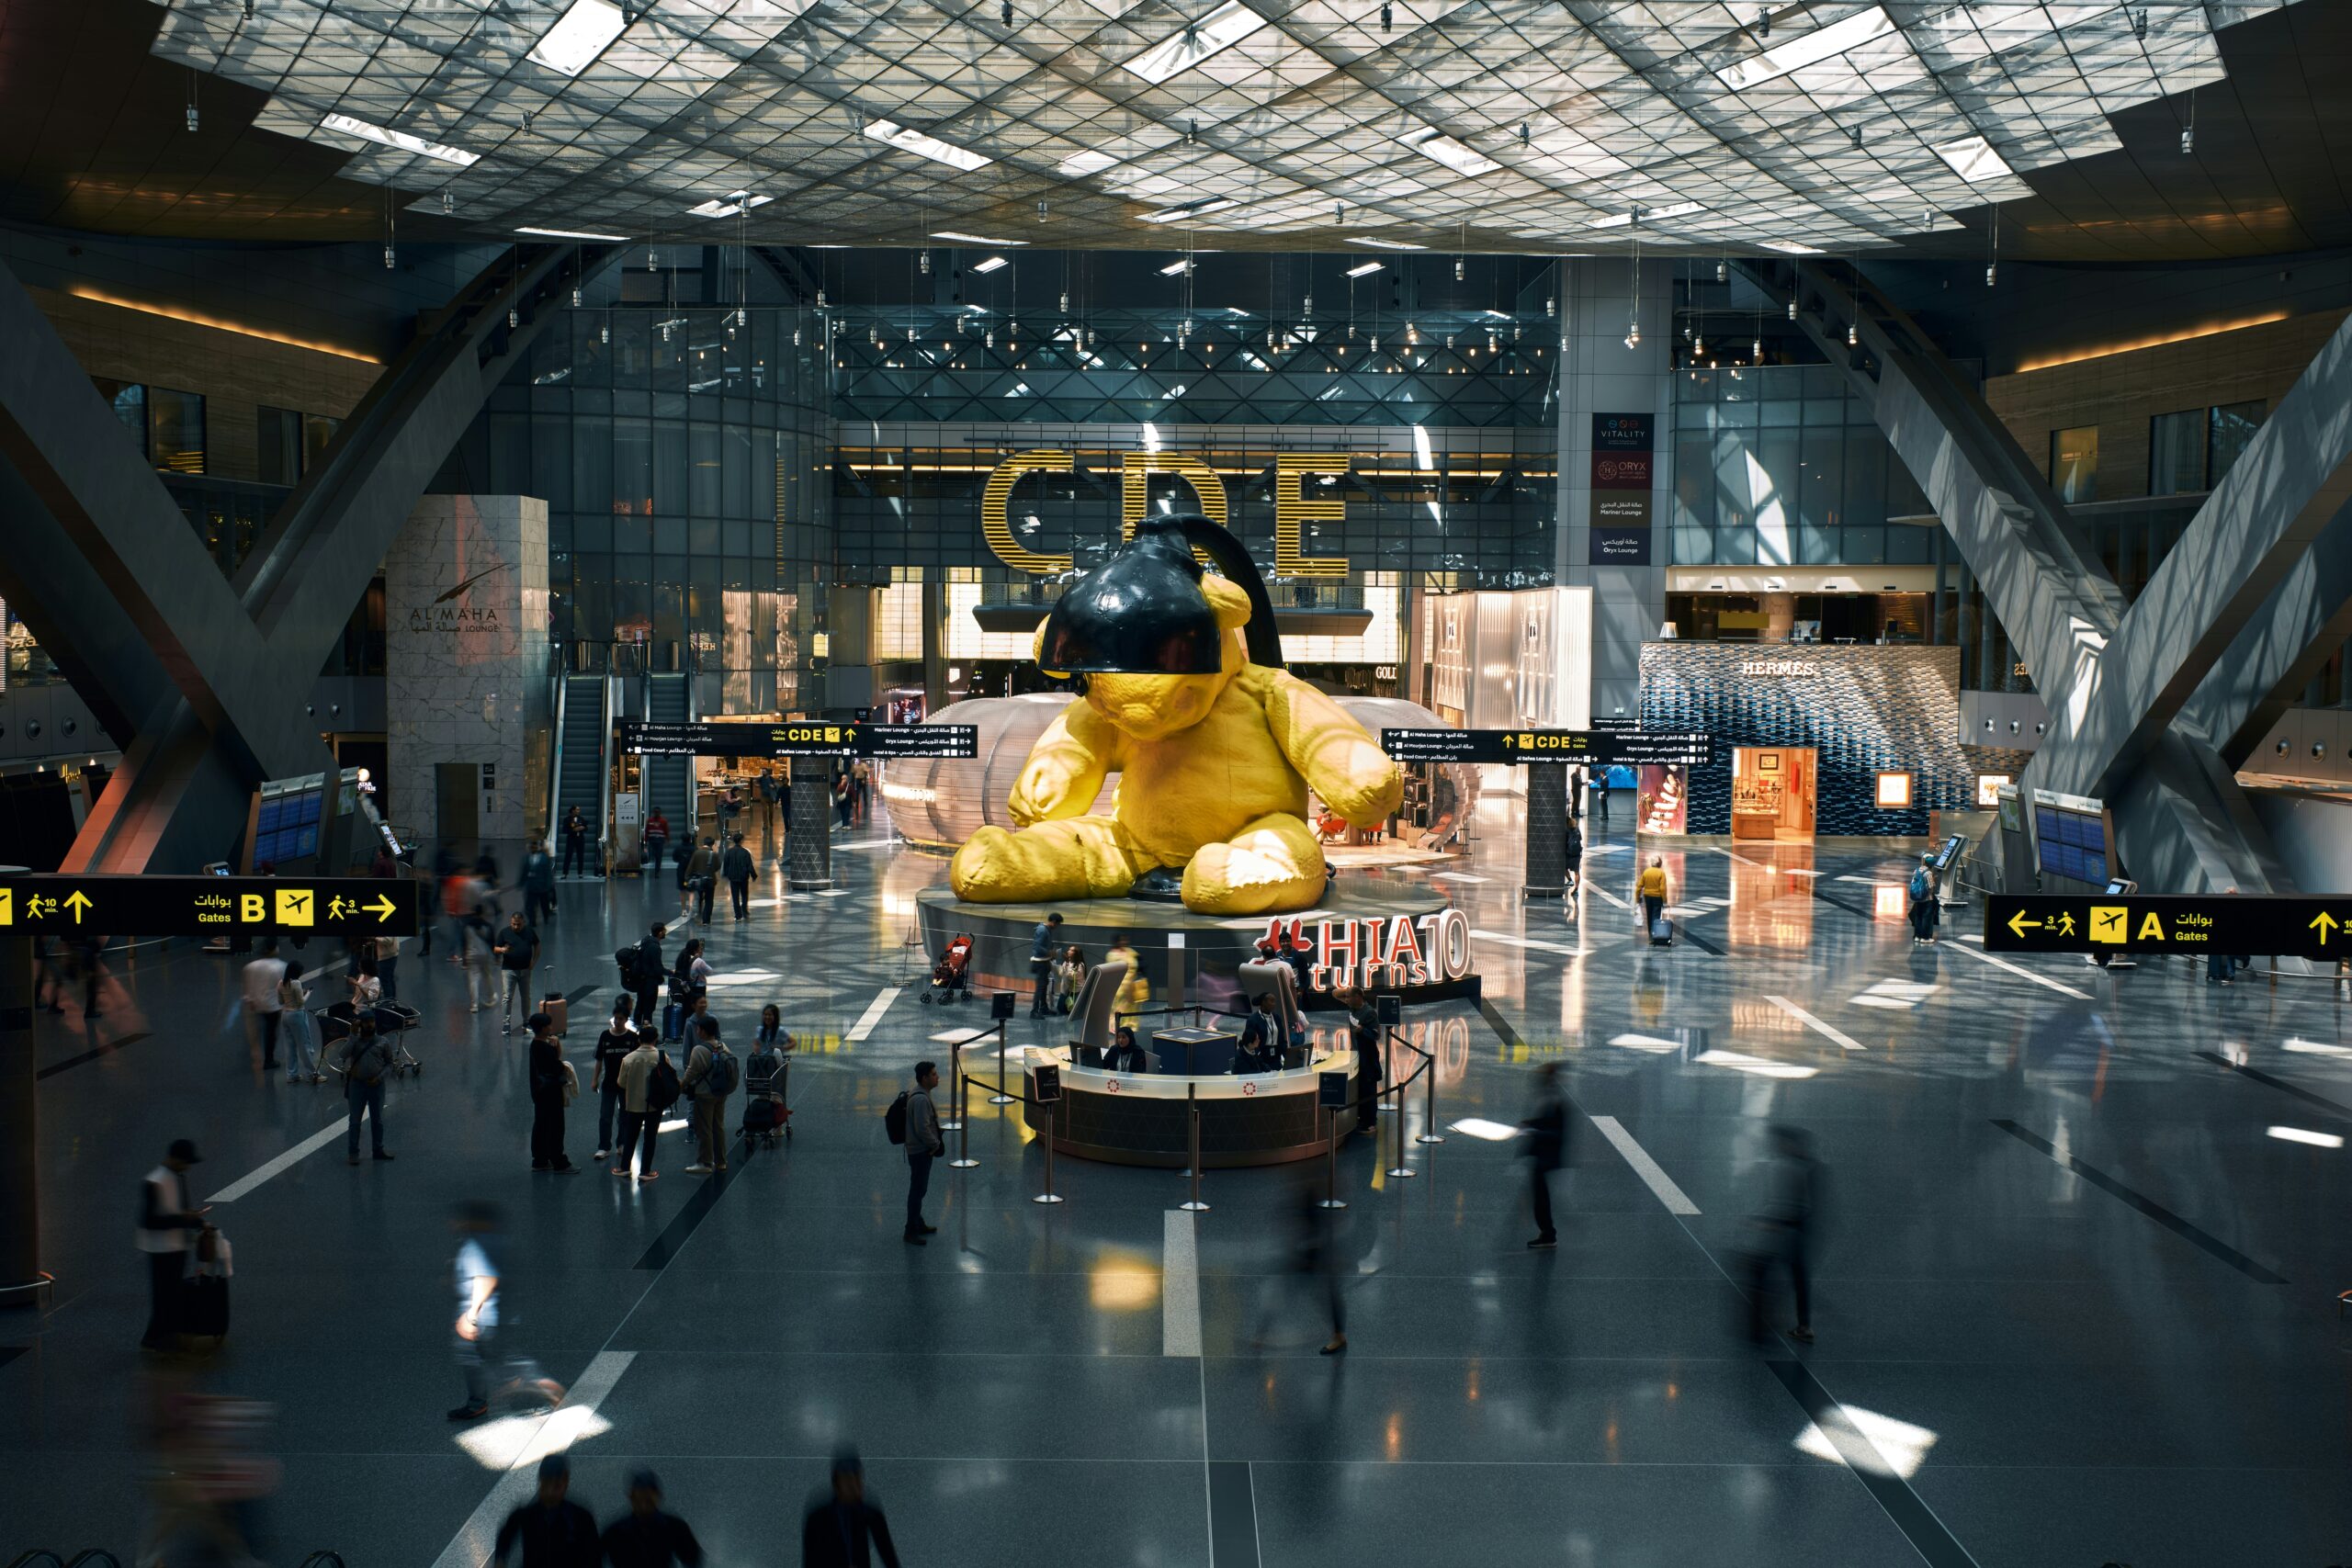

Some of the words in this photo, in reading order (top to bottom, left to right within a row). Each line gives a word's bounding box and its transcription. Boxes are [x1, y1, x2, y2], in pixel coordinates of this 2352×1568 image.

[1619, 462, 1646, 470] ORYX
[411, 608, 432, 620] AL
[441, 608, 497, 620] MAHA
[788, 729, 821, 740] CDE
[1537, 737, 1570, 748] CDE
[45, 898, 56, 907] 10
[195, 895, 231, 908] بوابات
[241, 895, 266, 922] B
[198, 913, 231, 922] Gates
[2048, 916, 2053, 924] 3
[2177, 913, 2212, 927] بوابات
[2137, 912, 2165, 940] A
[2176, 931, 2208, 941] Gates
[1309, 961, 1426, 990] turns
